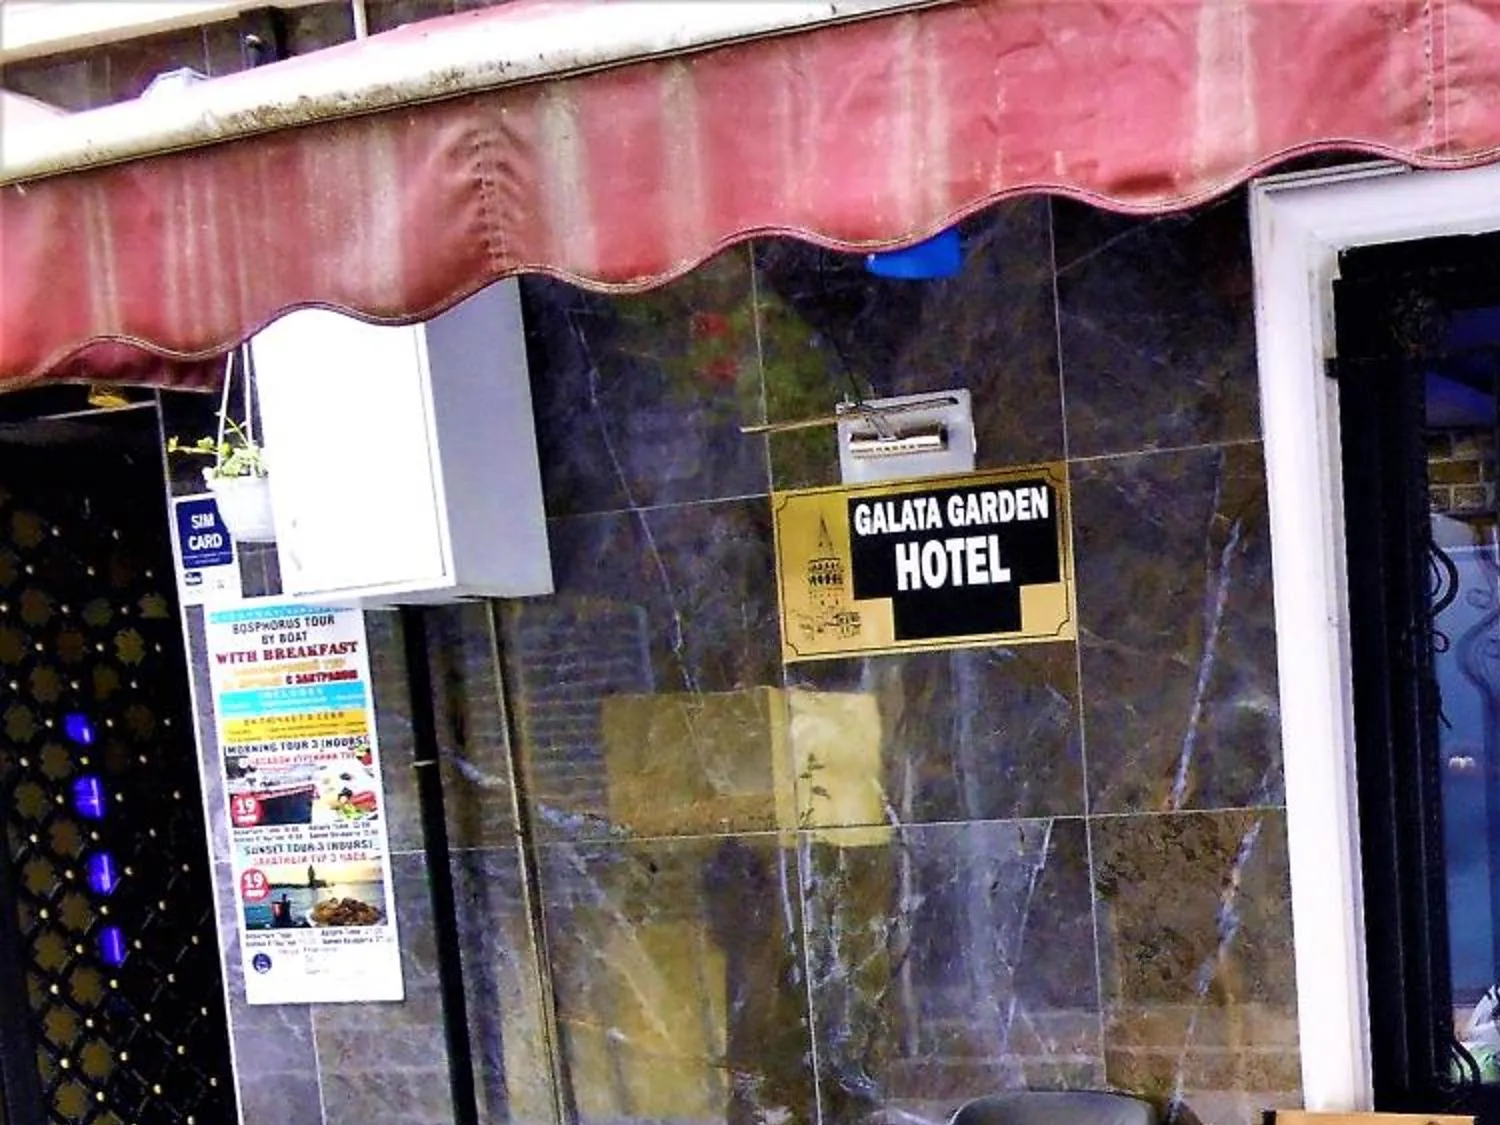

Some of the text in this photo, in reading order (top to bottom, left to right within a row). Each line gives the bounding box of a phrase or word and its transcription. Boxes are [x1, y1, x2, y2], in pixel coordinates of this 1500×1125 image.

[854, 485, 1049, 536] GALATA GARDEN
[191, 512, 215, 529] SIM
[188, 533, 222, 551] CARD
[895, 534, 1011, 591] HOTEL
[232, 614, 335, 635] BOSPHORUS TOUR
[261, 631, 308, 645] BY BOAT
[215, 641, 358, 665] WITH BREAKFAST
[227, 743, 279, 754] MORNING
[281, 739, 309, 751] TOUR
[236, 800, 257, 815] 19
[243, 844, 284, 856] SUNSET
[287, 842, 315, 853] TOUR
[244, 872, 265, 889] 19
